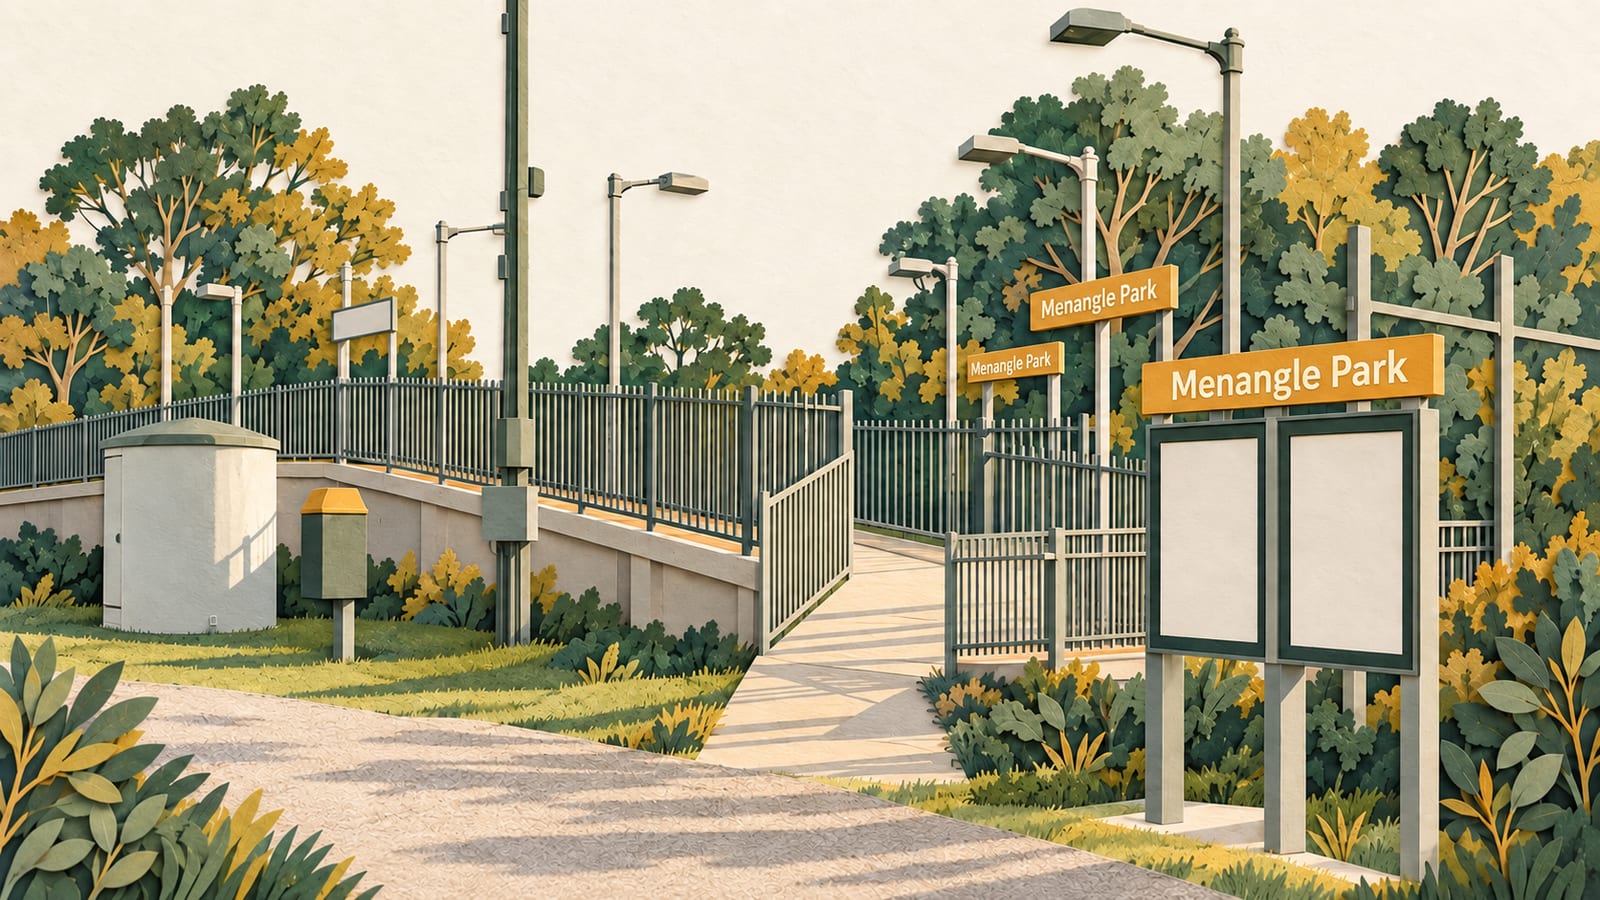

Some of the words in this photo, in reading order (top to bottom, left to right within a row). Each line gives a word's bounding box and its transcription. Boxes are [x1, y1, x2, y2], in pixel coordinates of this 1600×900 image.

[1041, 287, 1116, 319] Menangle
[1120, 278, 1157, 305] Park
[971, 355, 1023, 376] Menangle
[1026, 351, 1051, 369] Park
[1172, 358, 1321, 401] Menangle
[1332, 349, 1408, 388] Park
